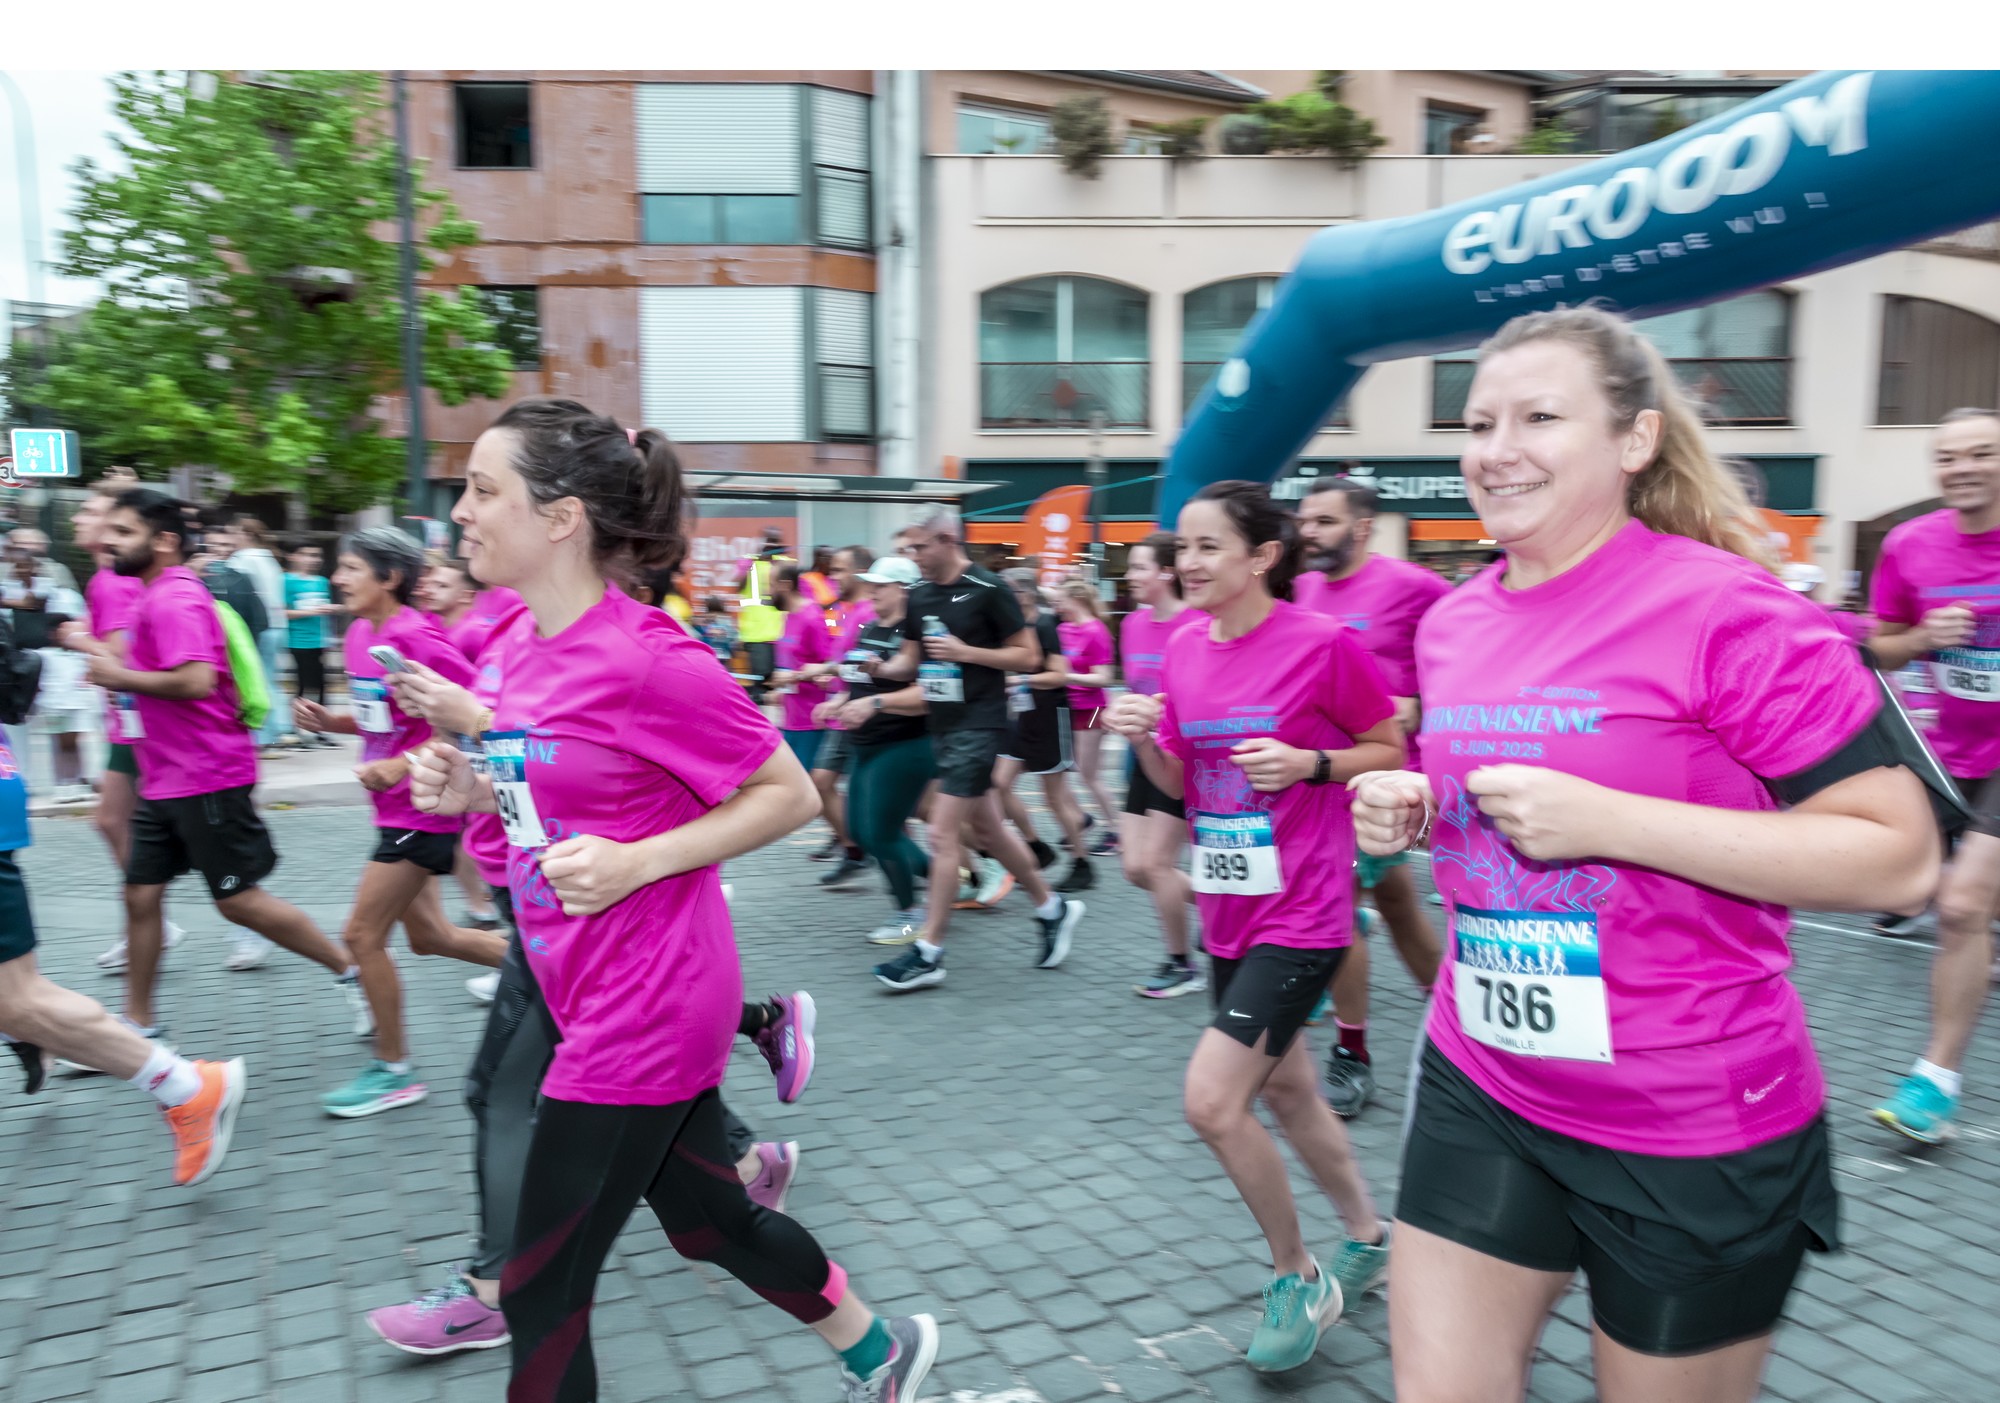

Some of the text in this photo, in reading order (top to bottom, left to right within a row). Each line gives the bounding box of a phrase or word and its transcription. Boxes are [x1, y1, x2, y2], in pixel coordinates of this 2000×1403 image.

[1376, 476, 1468, 500] SUPE
[1501, 740, 1544, 758] 2025
[1475, 975, 1556, 1034] 786
[1495, 1034, 1536, 1051] CAMILLE
